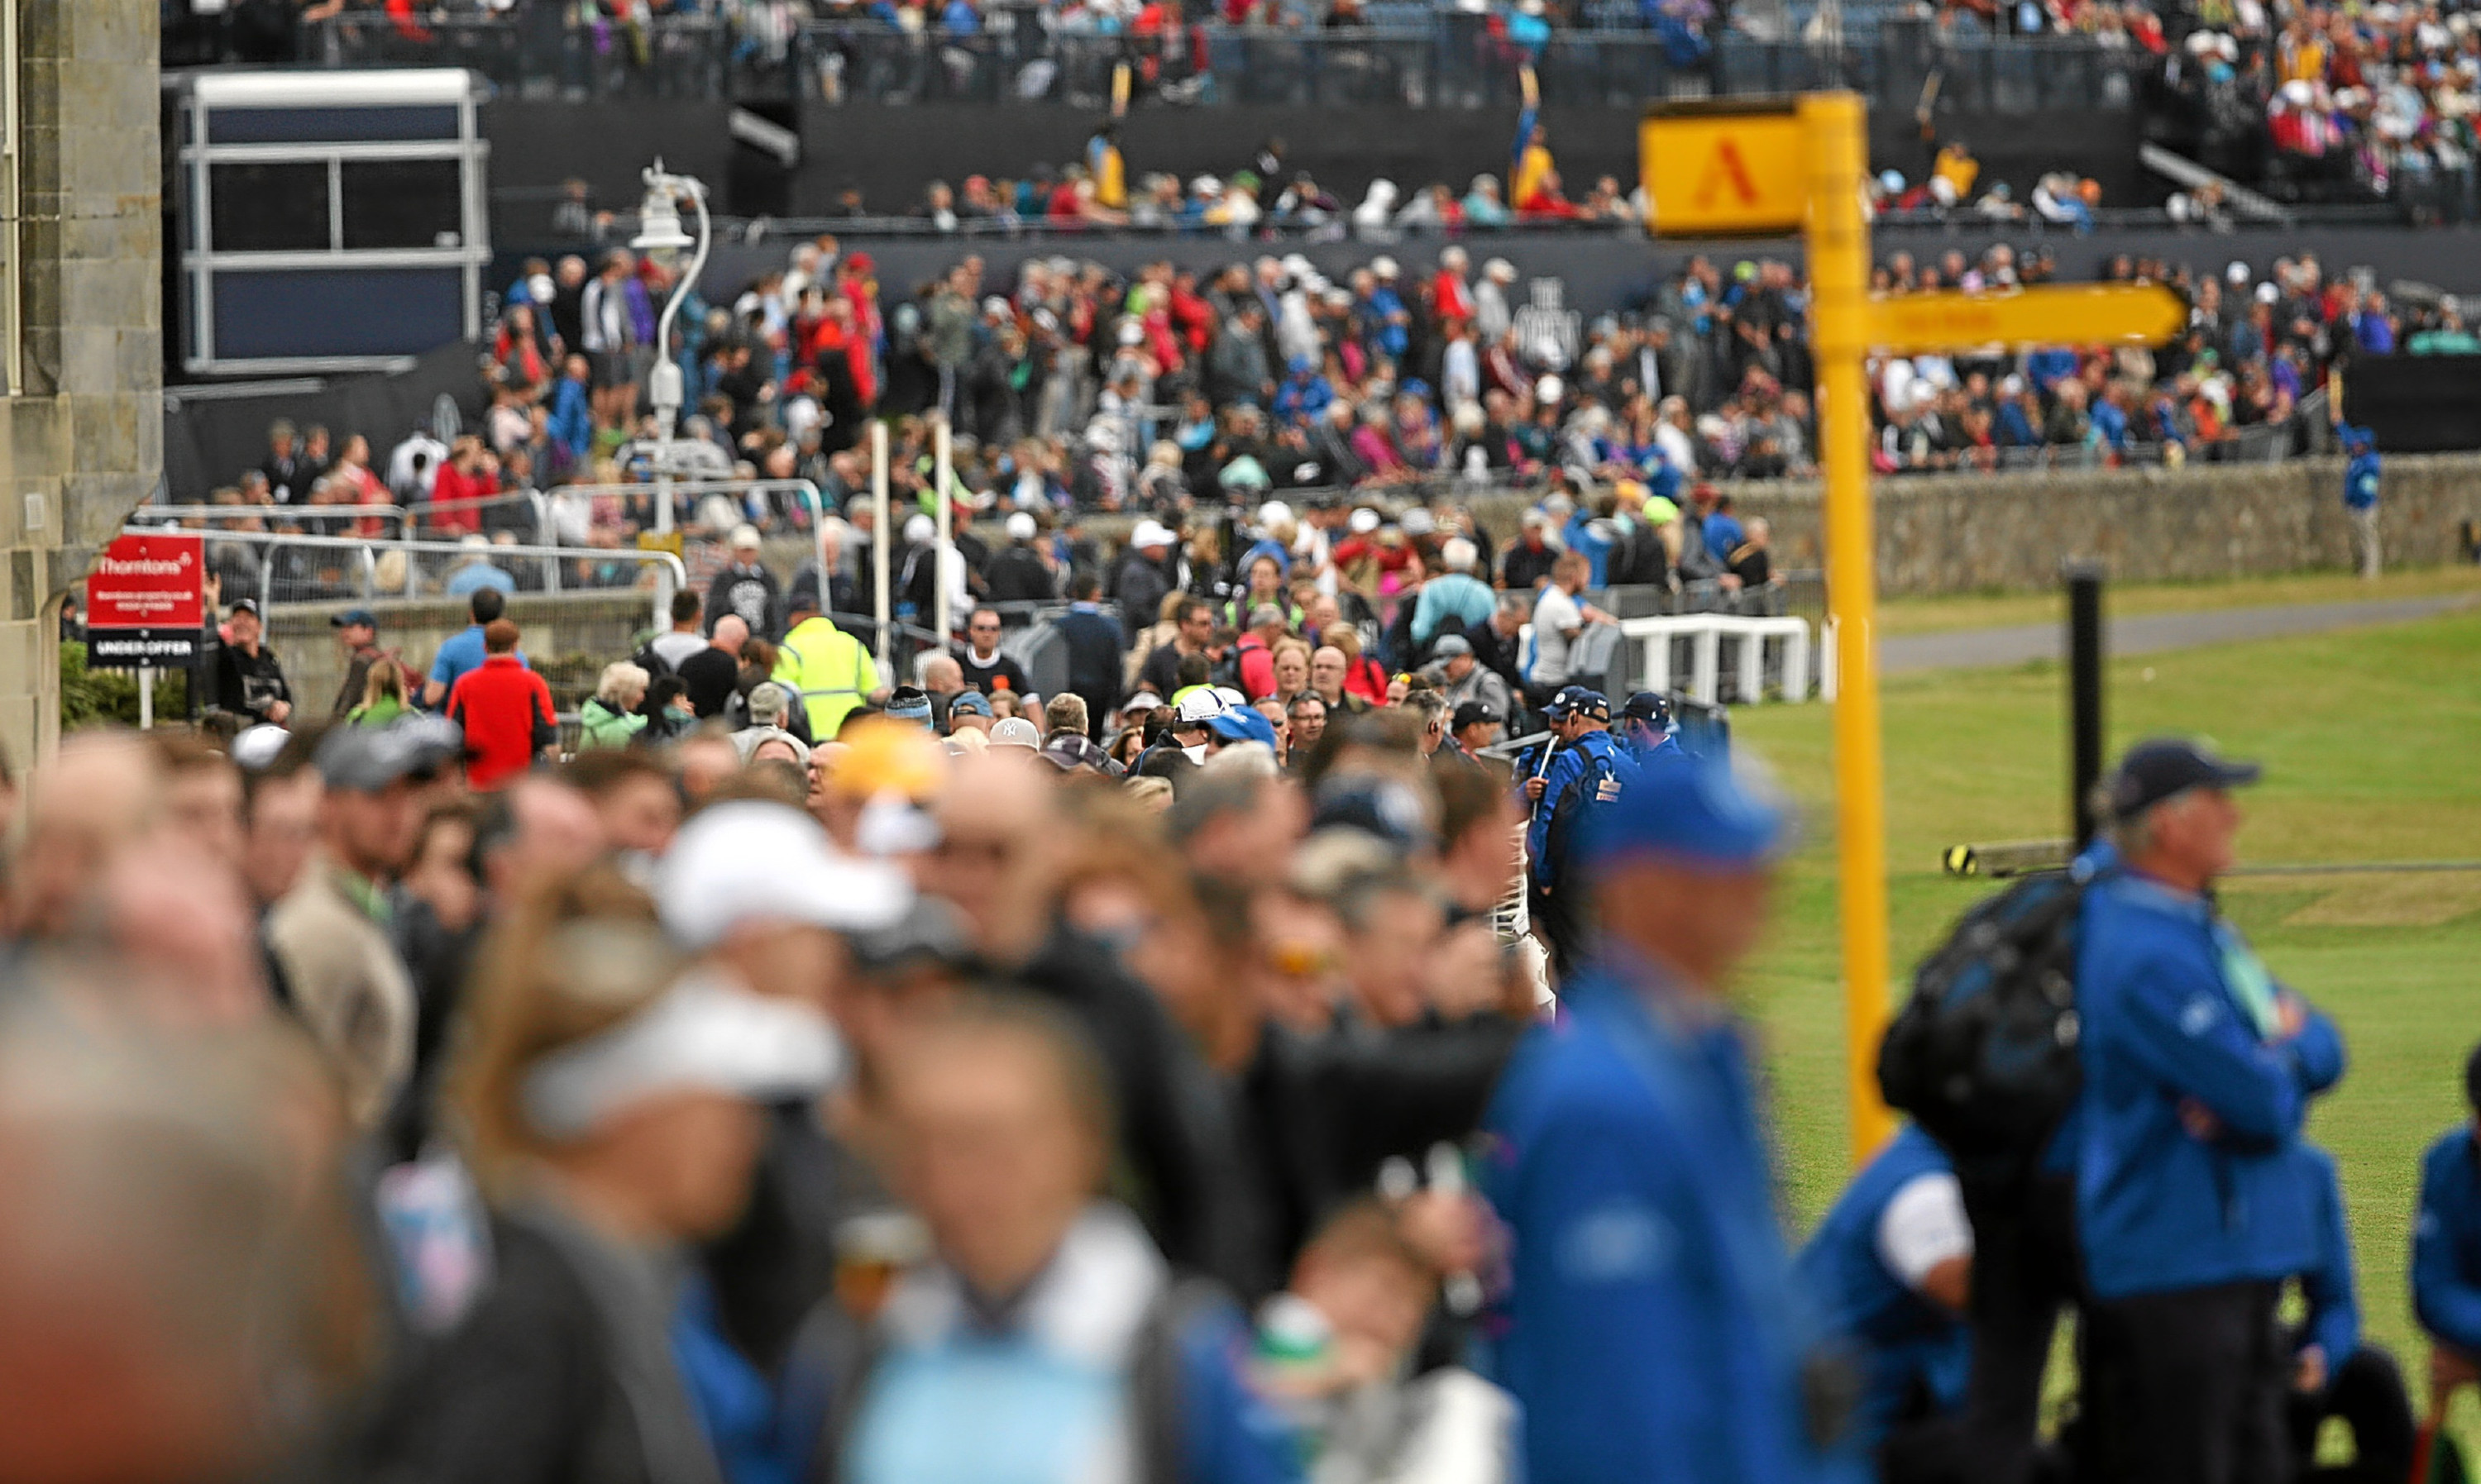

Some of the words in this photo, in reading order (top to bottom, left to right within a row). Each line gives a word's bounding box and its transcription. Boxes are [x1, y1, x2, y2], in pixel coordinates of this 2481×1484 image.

[98, 556, 182, 575] Thorntons
[97, 640, 146, 656] UNDER
[146, 640, 192, 656] OFFER
[1002, 721, 1017, 737] NY
